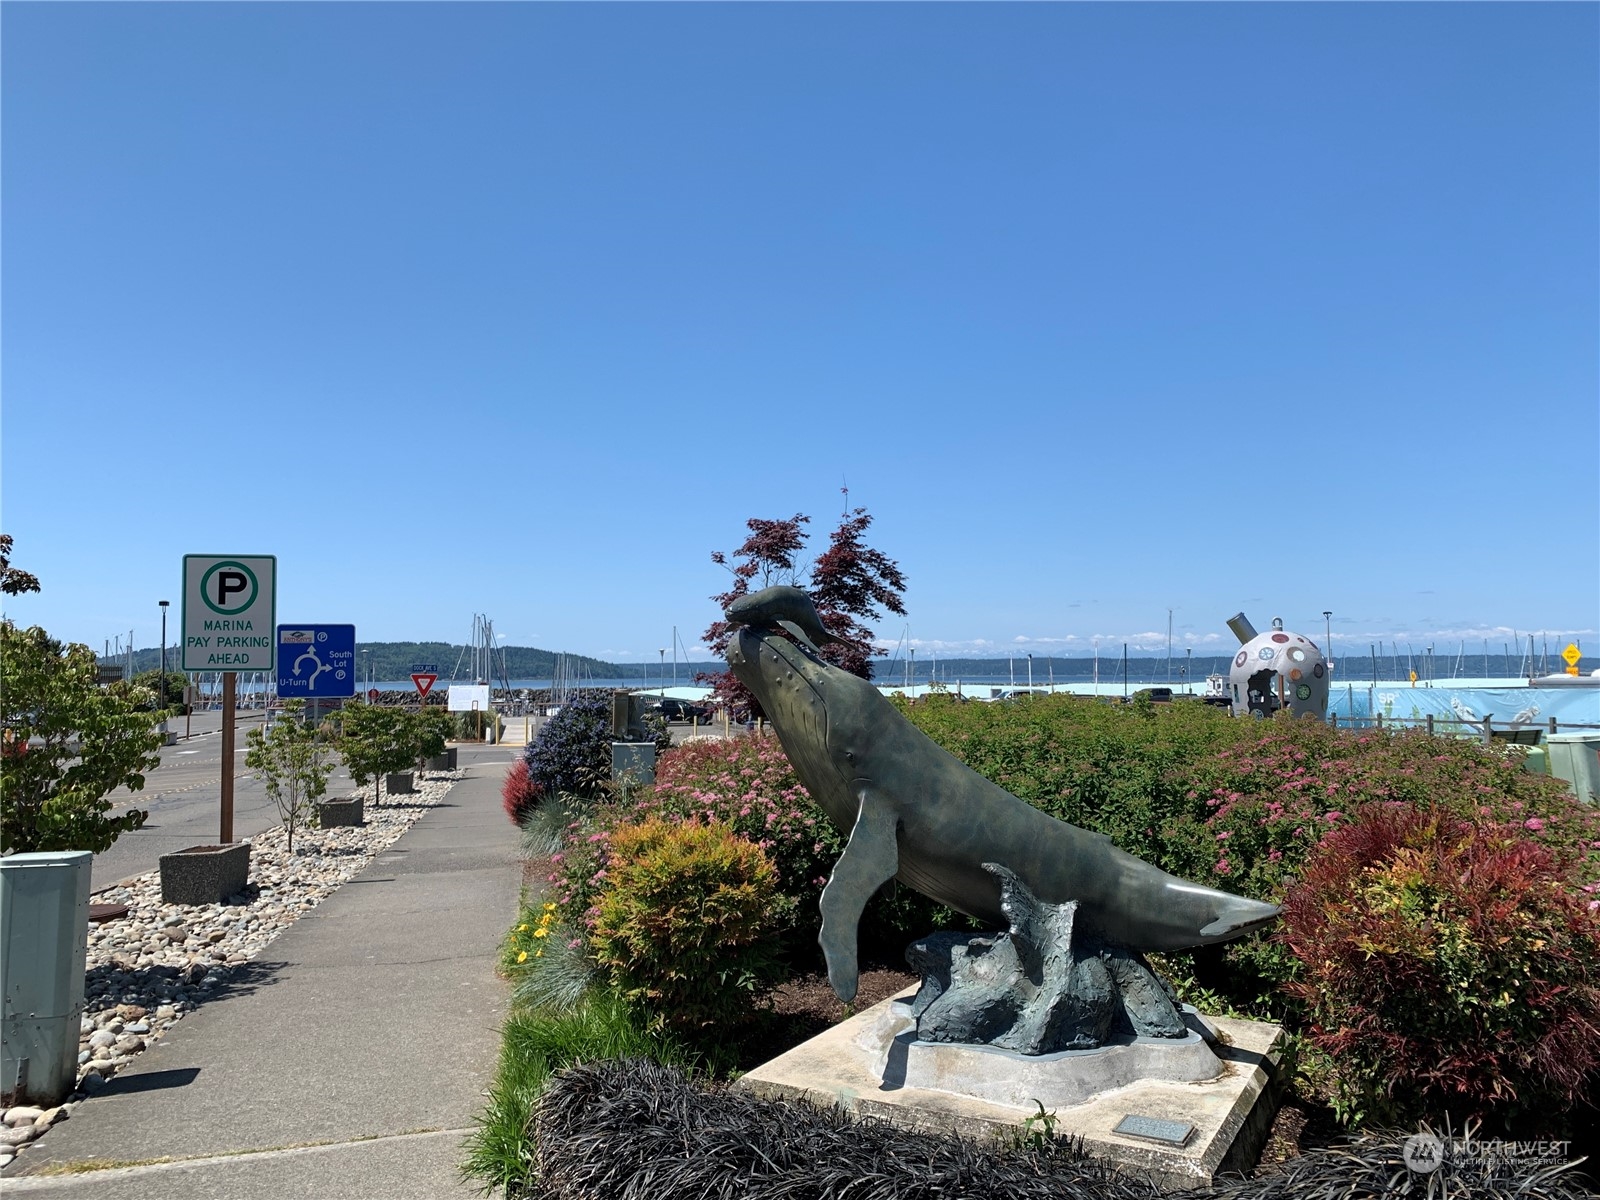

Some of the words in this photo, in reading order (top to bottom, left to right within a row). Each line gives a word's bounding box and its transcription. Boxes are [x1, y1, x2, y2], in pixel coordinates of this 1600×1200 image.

[218, 571, 248, 605] P
[204, 620, 254, 631] MARINA
[187, 637, 211, 648] PAY
[217, 637, 270, 648] PARKING
[207, 653, 250, 664] AHEAD
[329, 650, 353, 659] South
[279, 678, 307, 686] U-Turn
